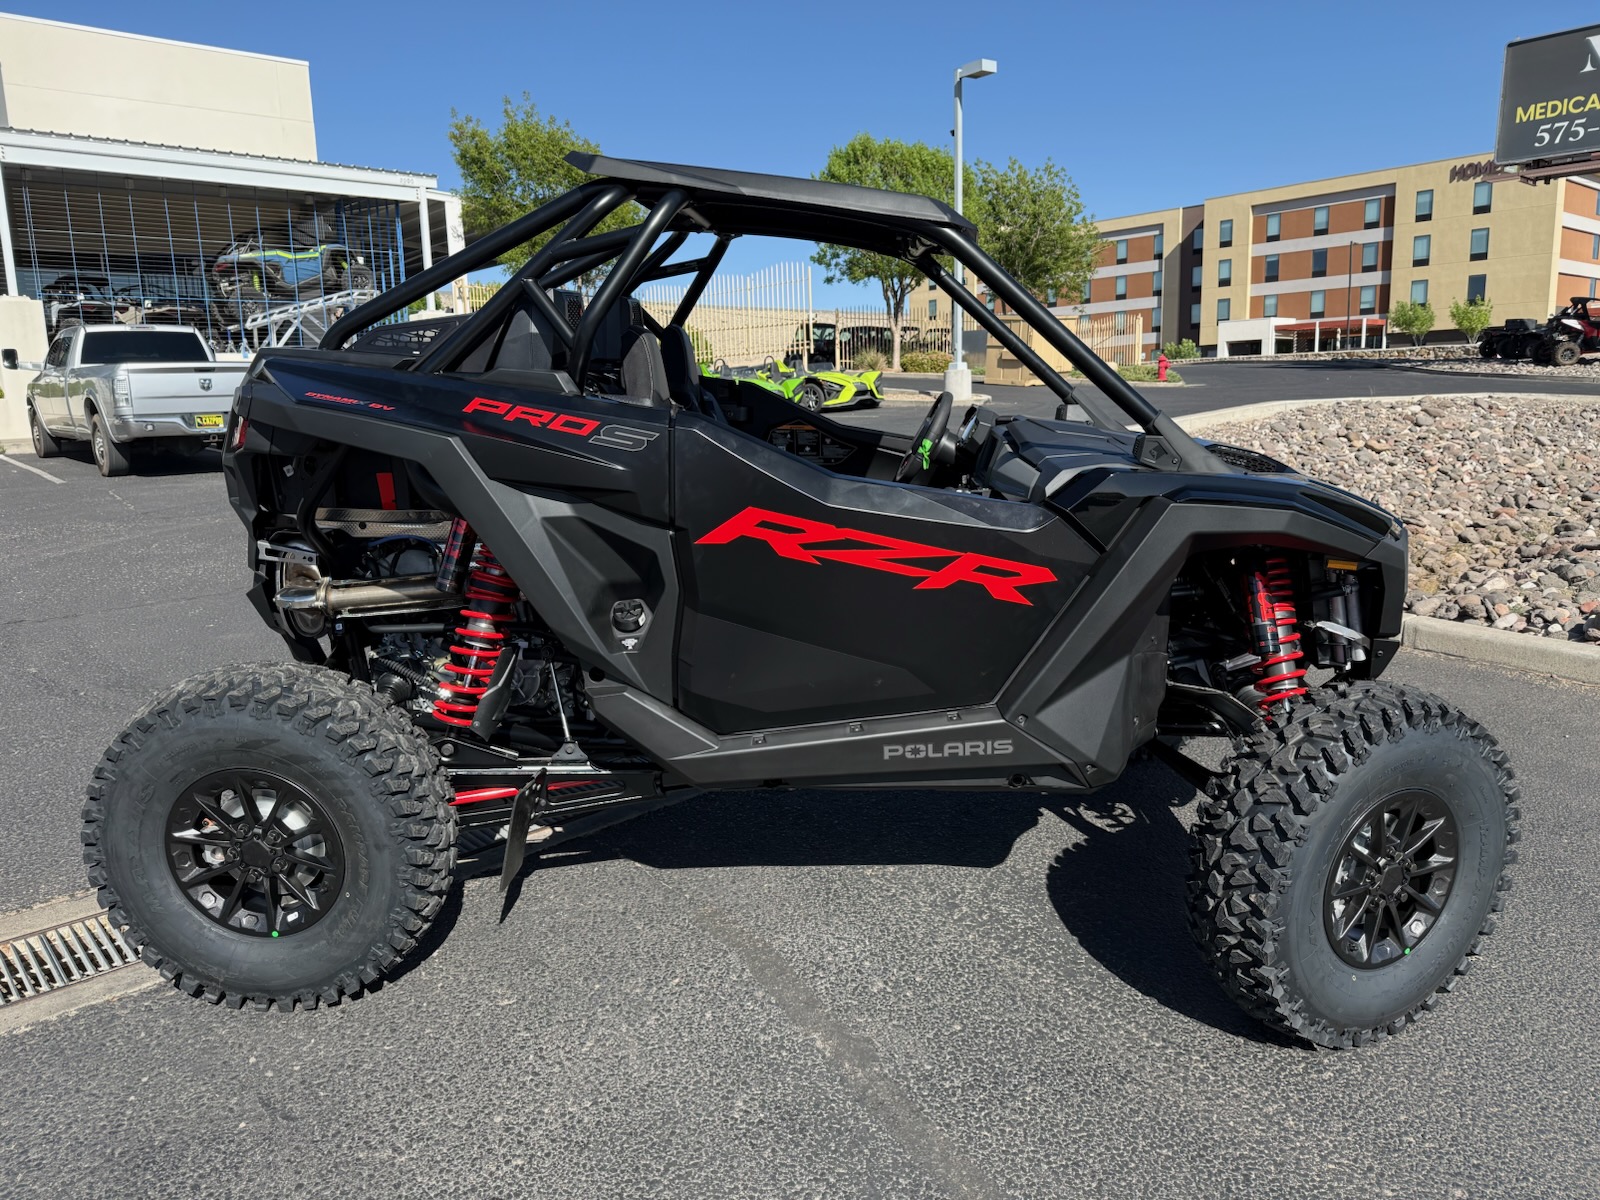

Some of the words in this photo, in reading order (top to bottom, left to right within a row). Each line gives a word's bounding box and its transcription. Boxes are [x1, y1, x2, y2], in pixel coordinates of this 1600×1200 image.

[1515, 93, 1600, 124] MEDICA
[1534, 117, 1600, 147] 575-
[462, 397, 601, 437] PRO
[588, 424, 660, 452] S
[694, 506, 1058, 606] RZR
[883, 739, 1014, 760] POLARIS
